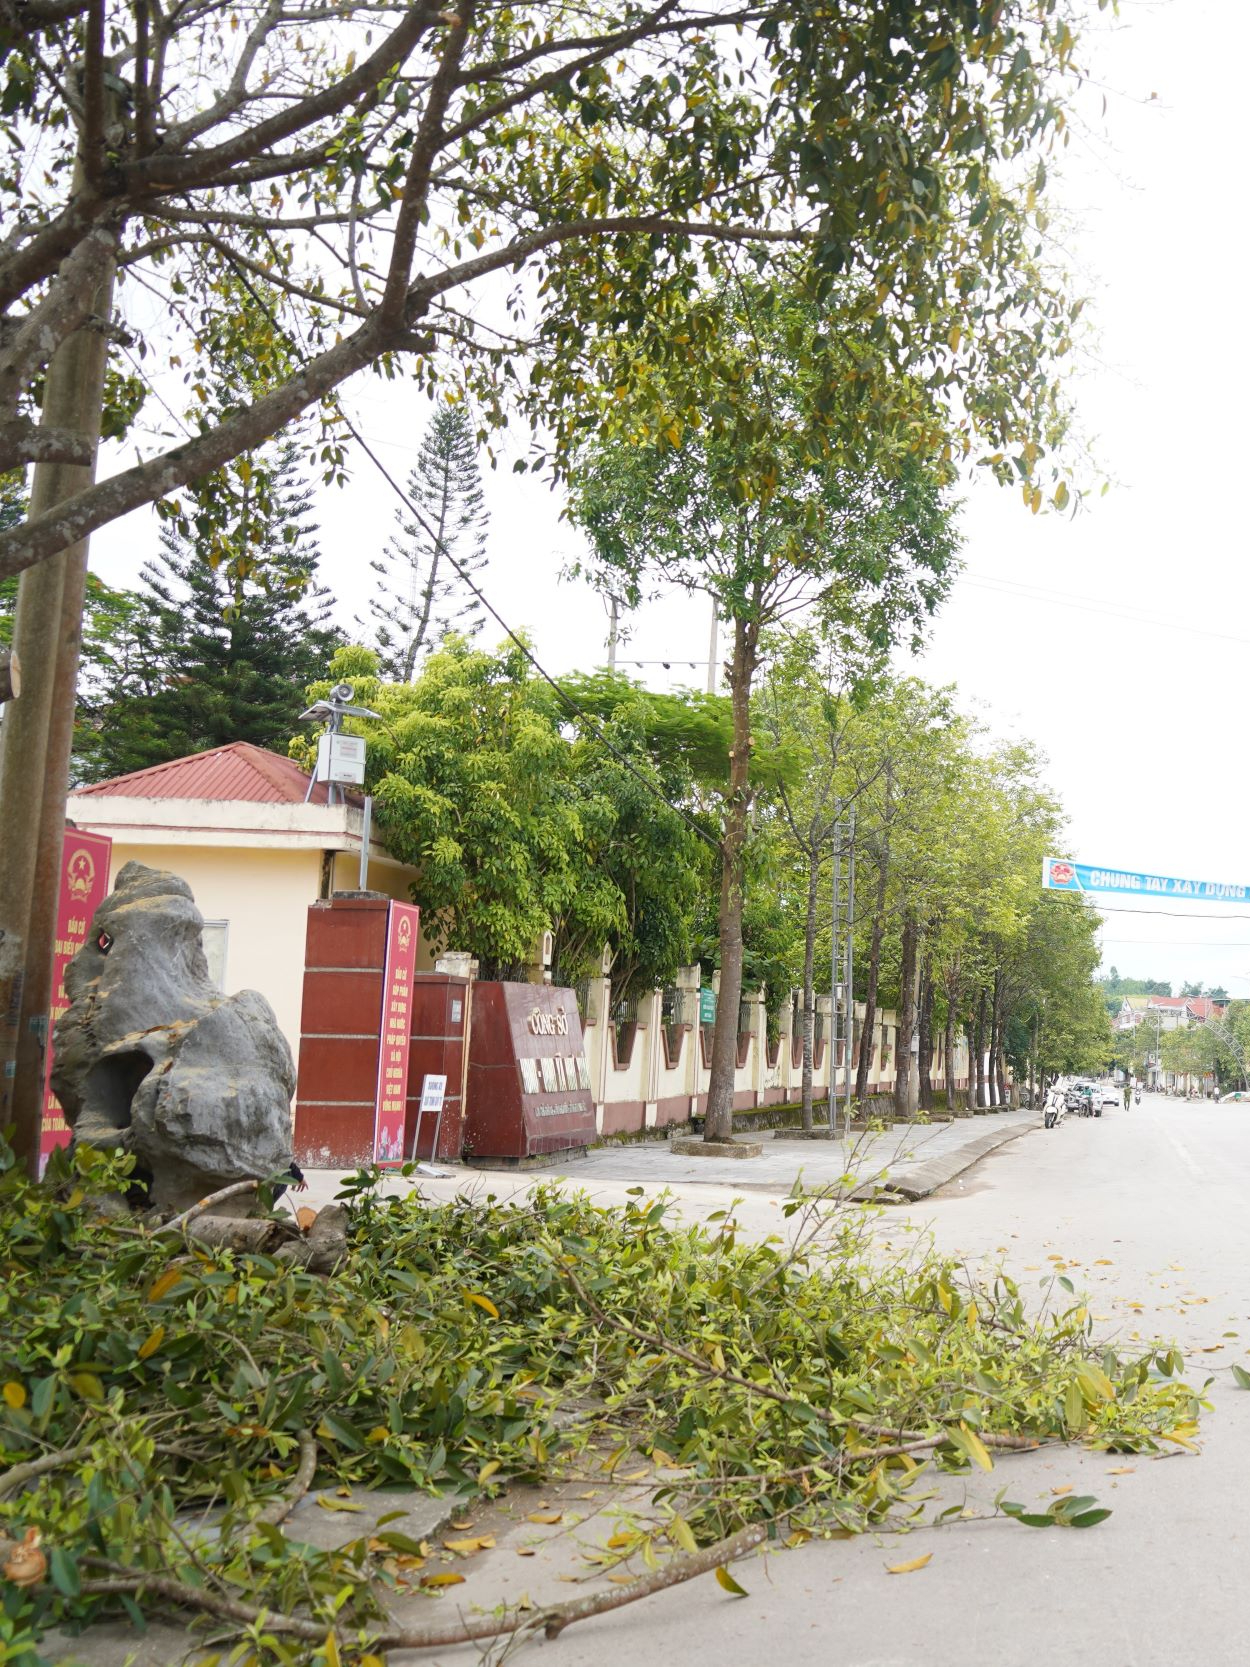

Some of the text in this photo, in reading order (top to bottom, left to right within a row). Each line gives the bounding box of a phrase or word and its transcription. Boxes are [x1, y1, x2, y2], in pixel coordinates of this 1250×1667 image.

[1089, 869, 1141, 889] CHUNG
[1145, 875, 1168, 892] TAY
[529, 1006, 555, 1035] CÔNG
